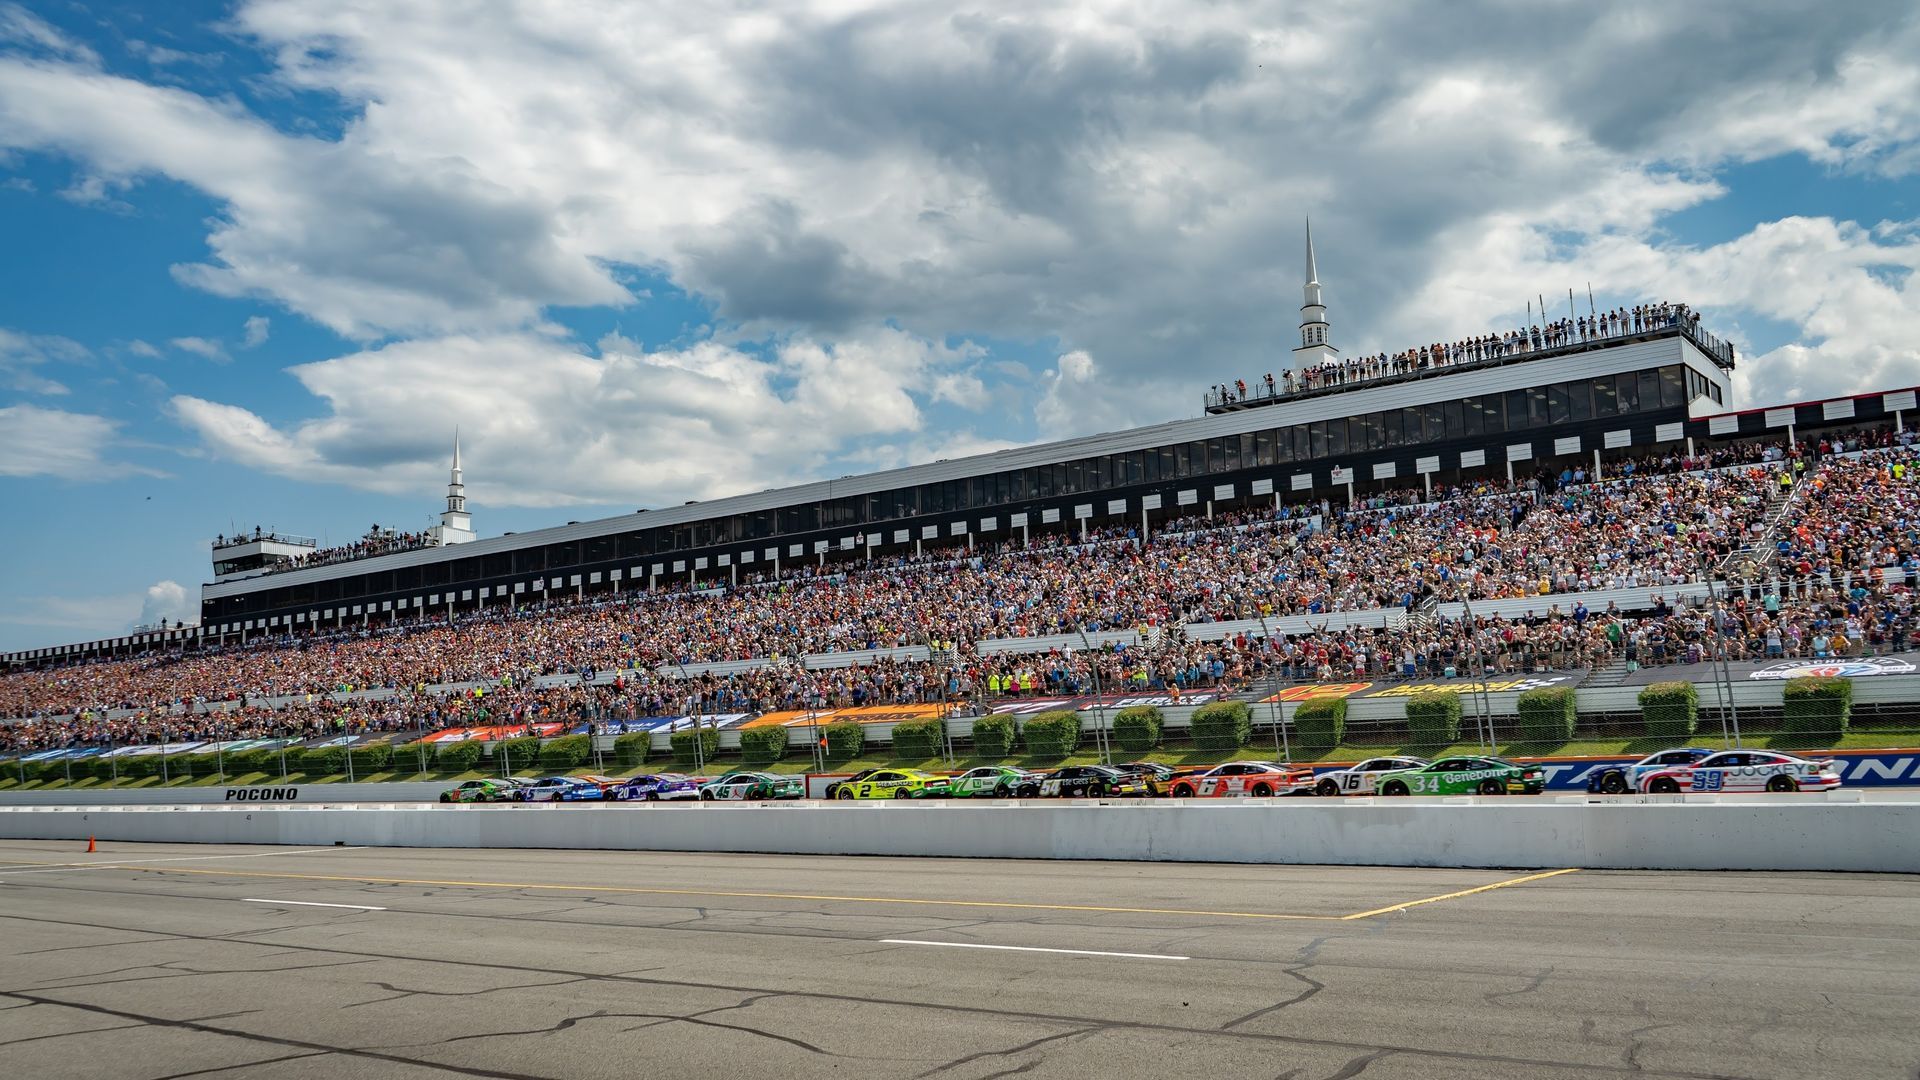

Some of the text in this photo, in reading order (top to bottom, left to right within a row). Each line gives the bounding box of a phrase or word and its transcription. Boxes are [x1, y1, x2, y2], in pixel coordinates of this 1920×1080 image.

[1442, 769, 1509, 784] Benebone
[1730, 764, 1806, 777] JOCKEY
[1039, 779, 1062, 797] 54
[1342, 774, 1361, 790] 16
[1412, 775, 1440, 793] 34
[225, 788, 298, 801] POCONO
[525, 786, 535, 801] 5
[617, 786, 630, 799] 20
[715, 785, 731, 799] 45
[859, 784, 872, 798] 2
